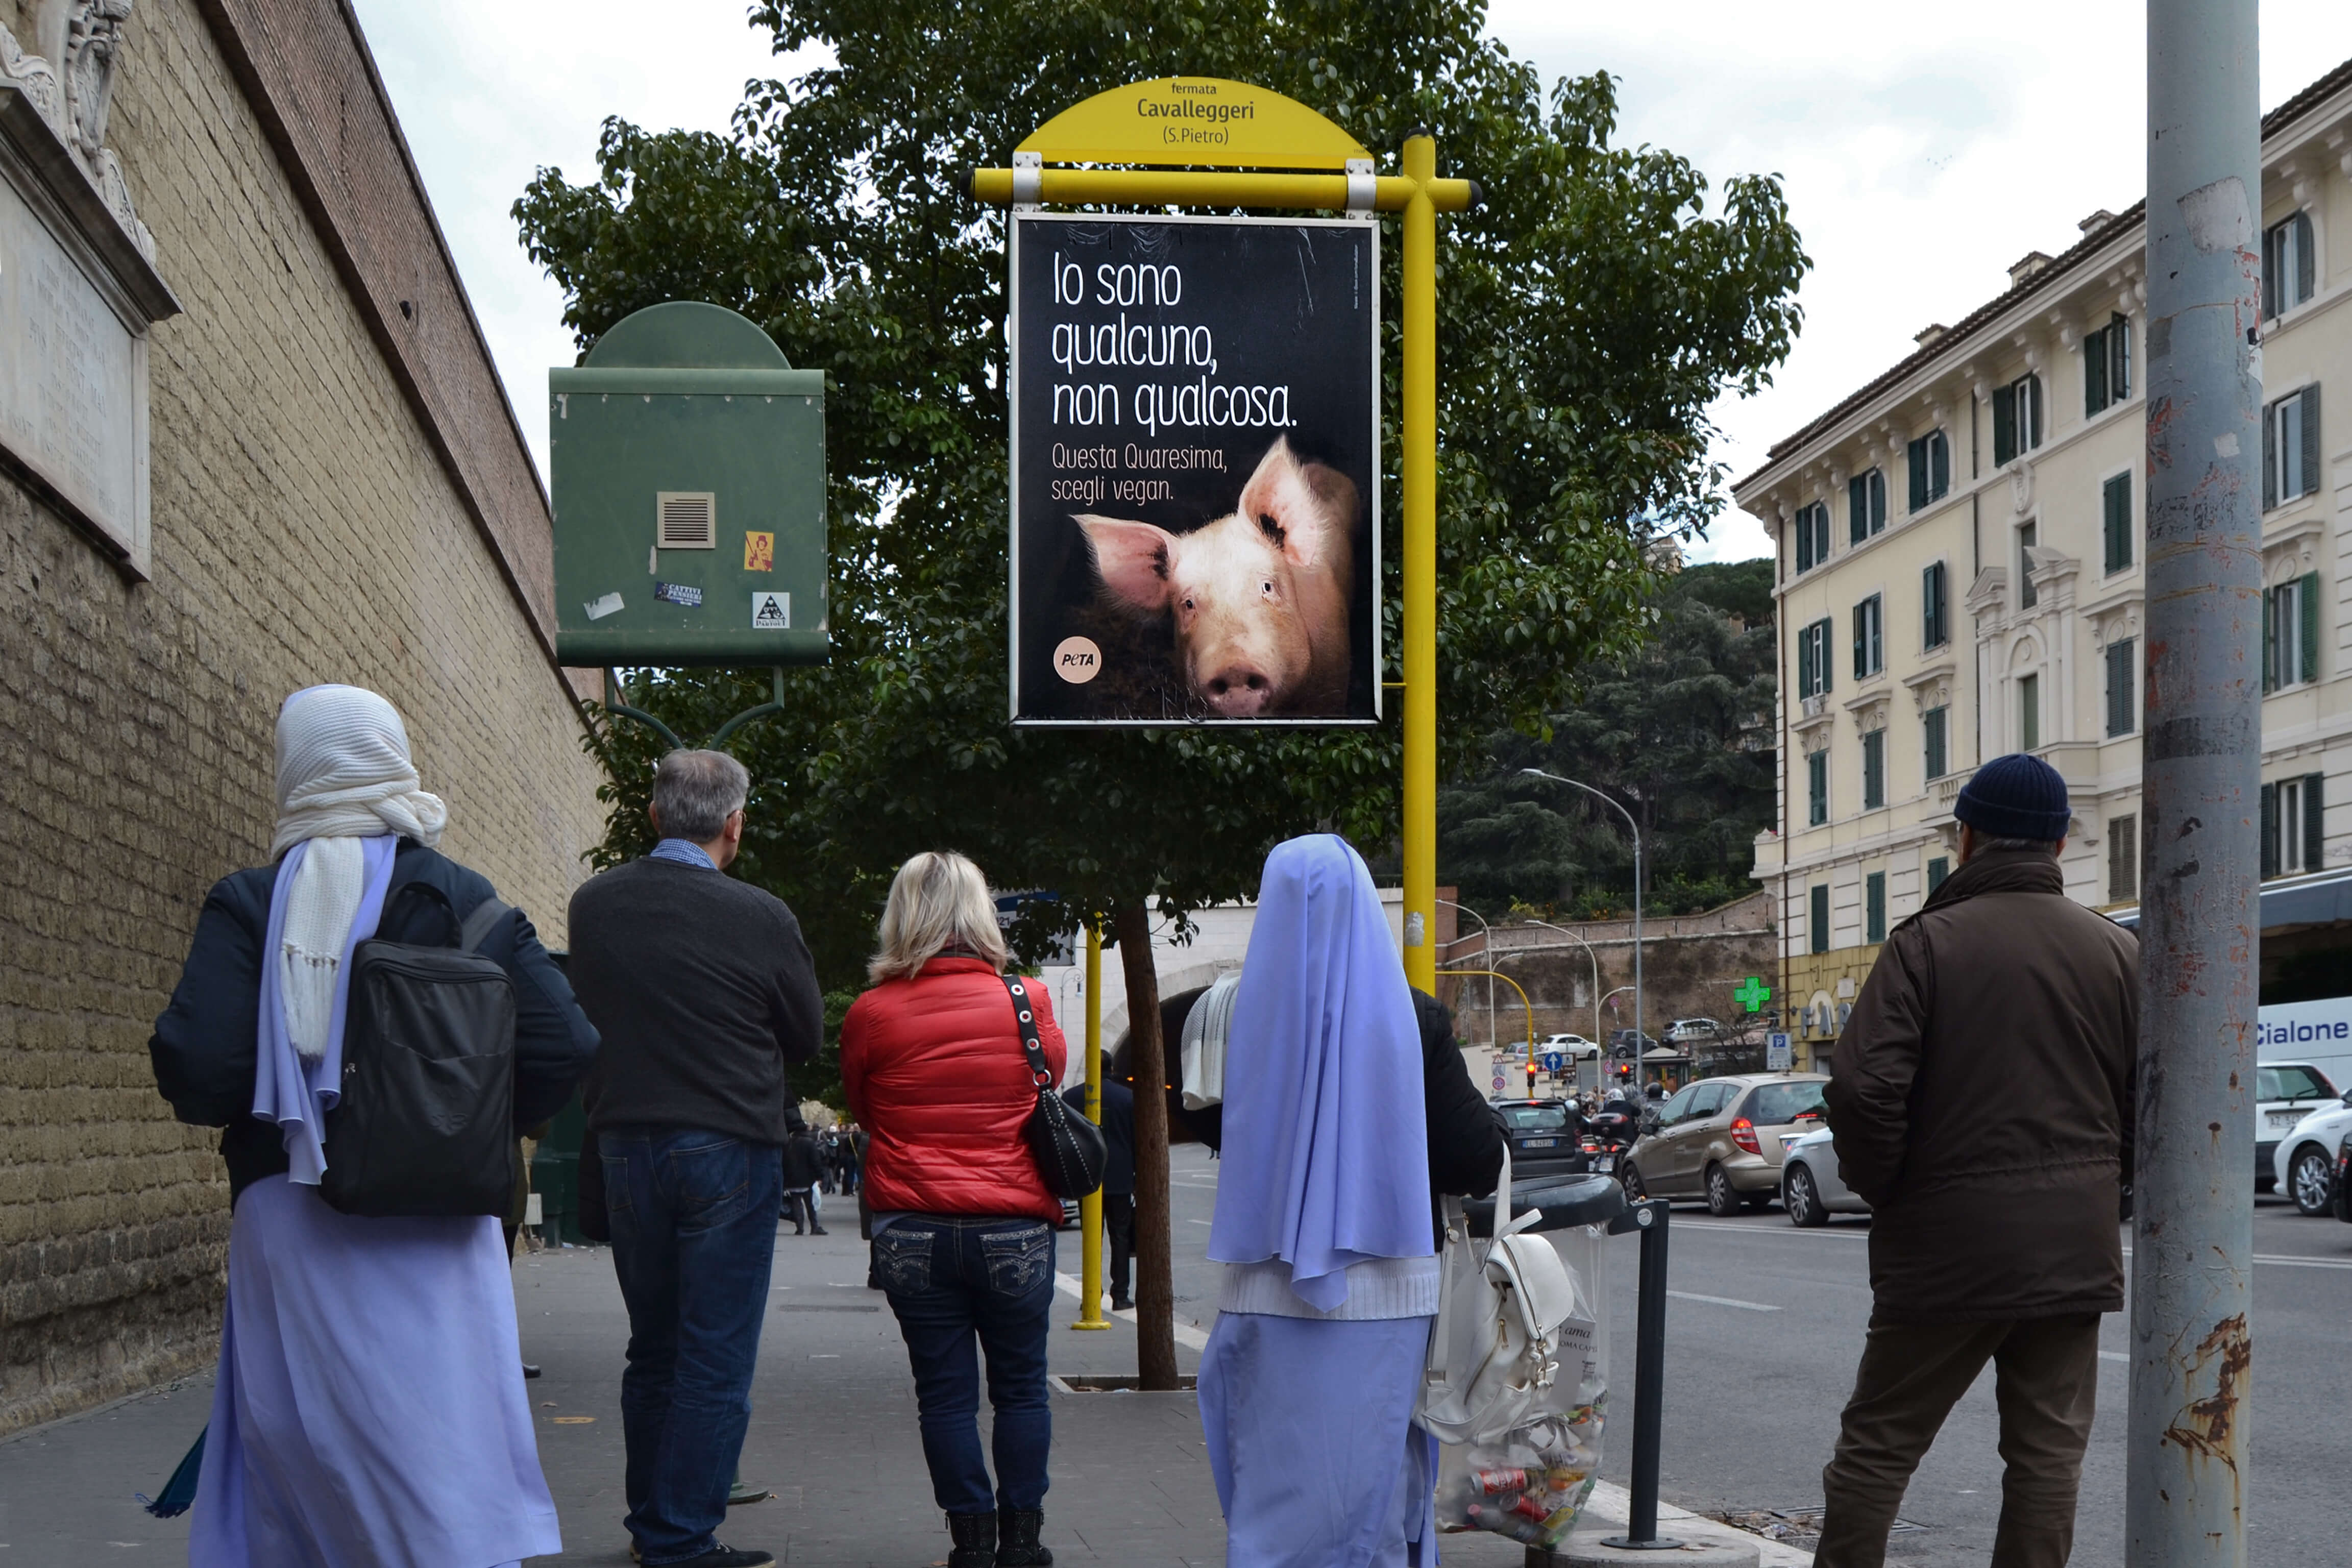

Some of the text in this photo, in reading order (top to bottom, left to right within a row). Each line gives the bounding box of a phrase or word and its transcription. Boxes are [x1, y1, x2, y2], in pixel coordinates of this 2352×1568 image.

[1171, 82, 1217, 95] fermata
[1137, 98, 1254, 123] Cavalleggeri
[1054, 252, 1182, 306] Io sono
[1051, 312, 1218, 375] qualcuno,
[1053, 375, 1297, 437] non qualcosa.
[1052, 443, 1228, 474] Questa Quaresima,
[1051, 476, 1174, 506] scegli vegan.
[1558, 1340, 1578, 1349] OMA
